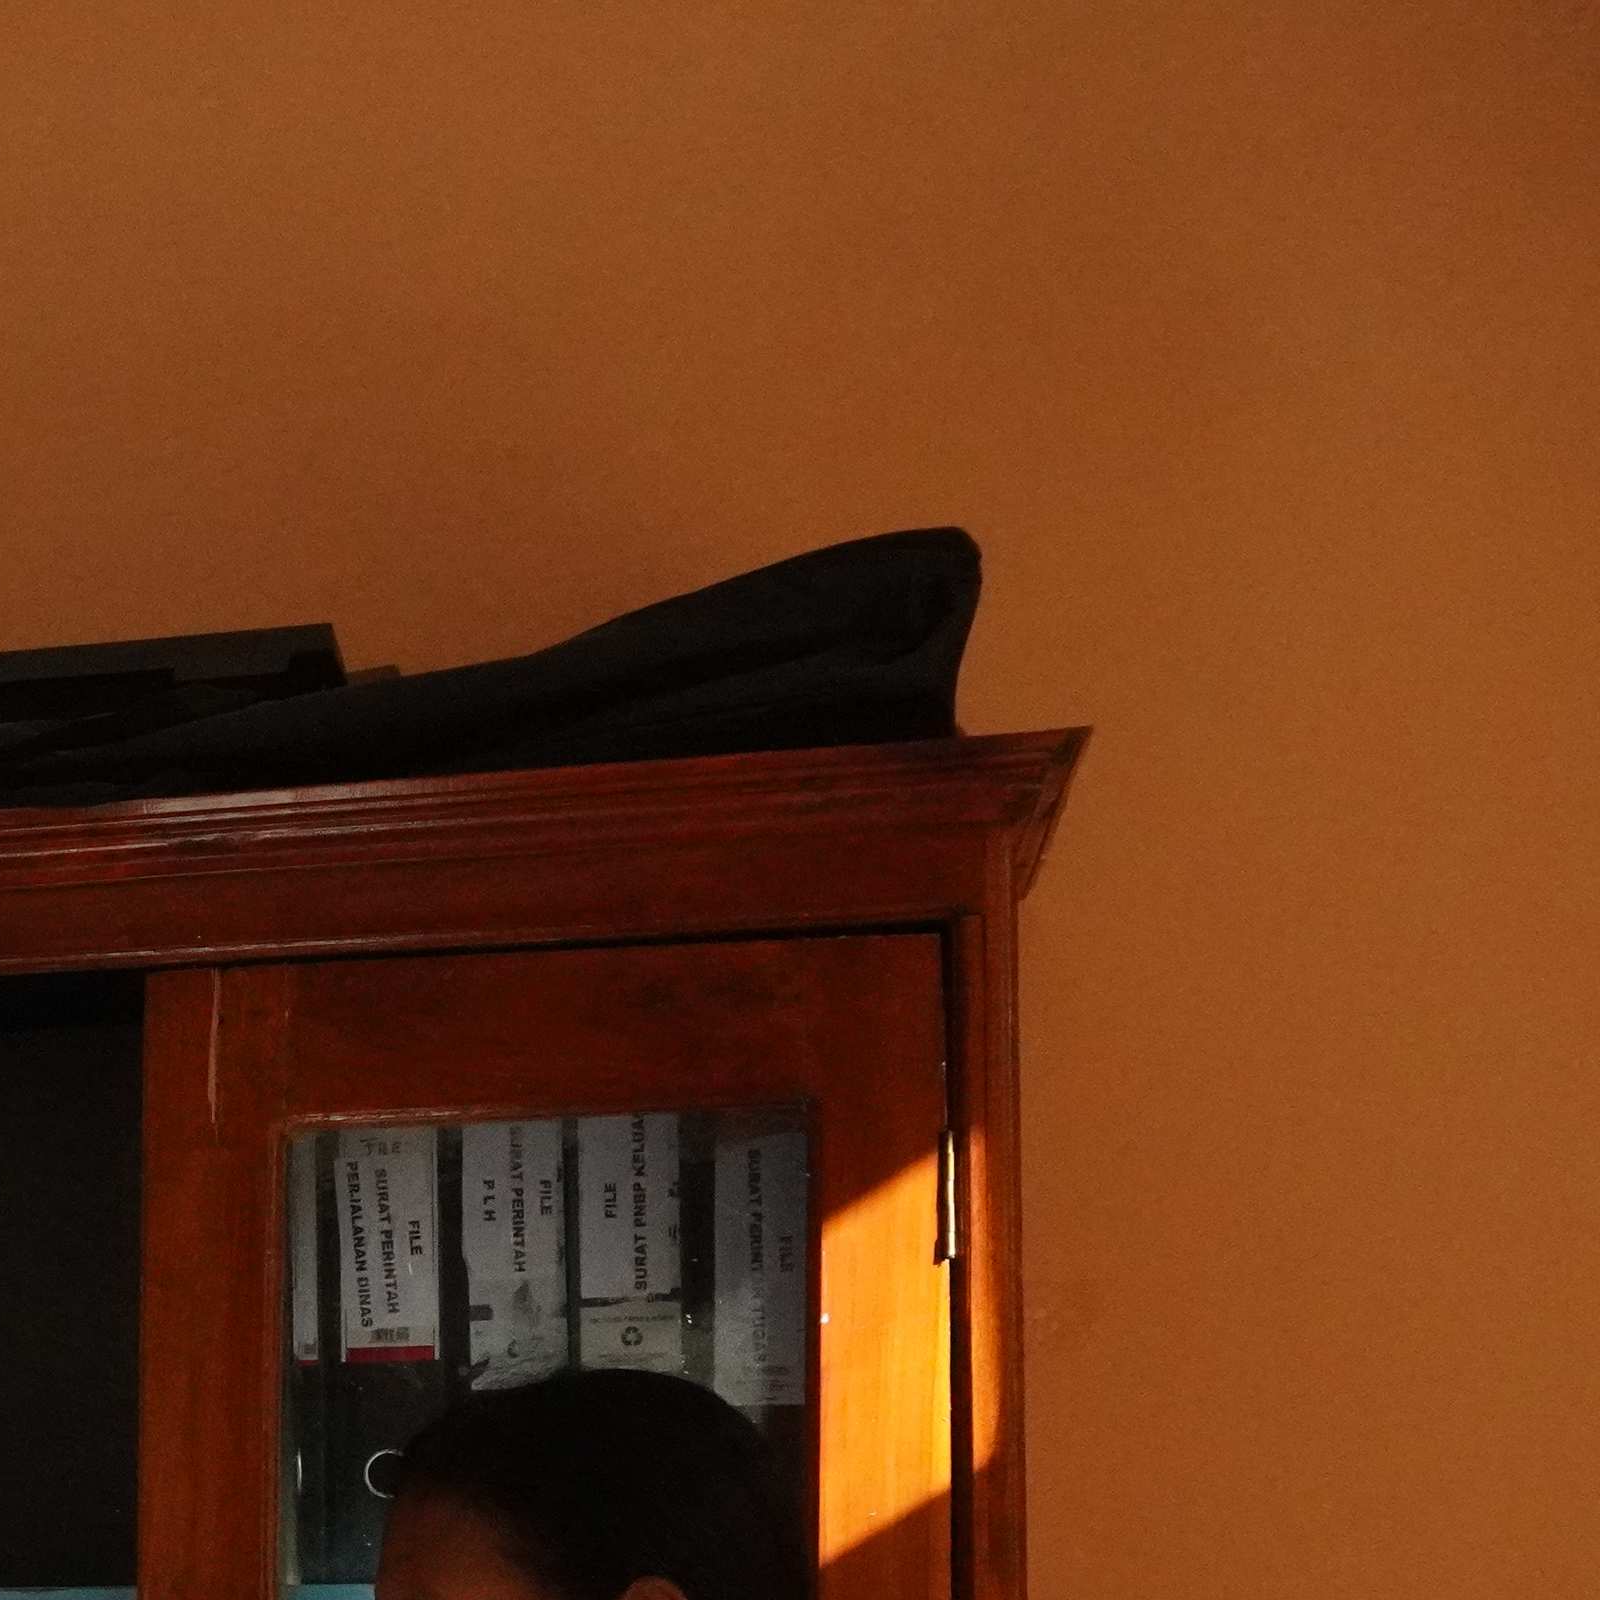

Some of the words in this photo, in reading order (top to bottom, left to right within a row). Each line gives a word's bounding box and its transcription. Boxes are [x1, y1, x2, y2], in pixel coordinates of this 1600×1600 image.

[631, 1119, 646, 1178] KELUA
[346, 1161, 368, 1274] PERJALANAN
[374, 1168, 391, 1225] SURAT
[539, 1179, 553, 1216] FILE
[604, 1182, 617, 1218] FILE
[408, 1220, 423, 1256] FILE
[511, 1188, 526, 1273] PERINTAH
[380, 1229, 401, 1313] PERINTAH
[634, 1233, 647, 1291] SURAT
[356, 1276, 373, 1328] DINAS
